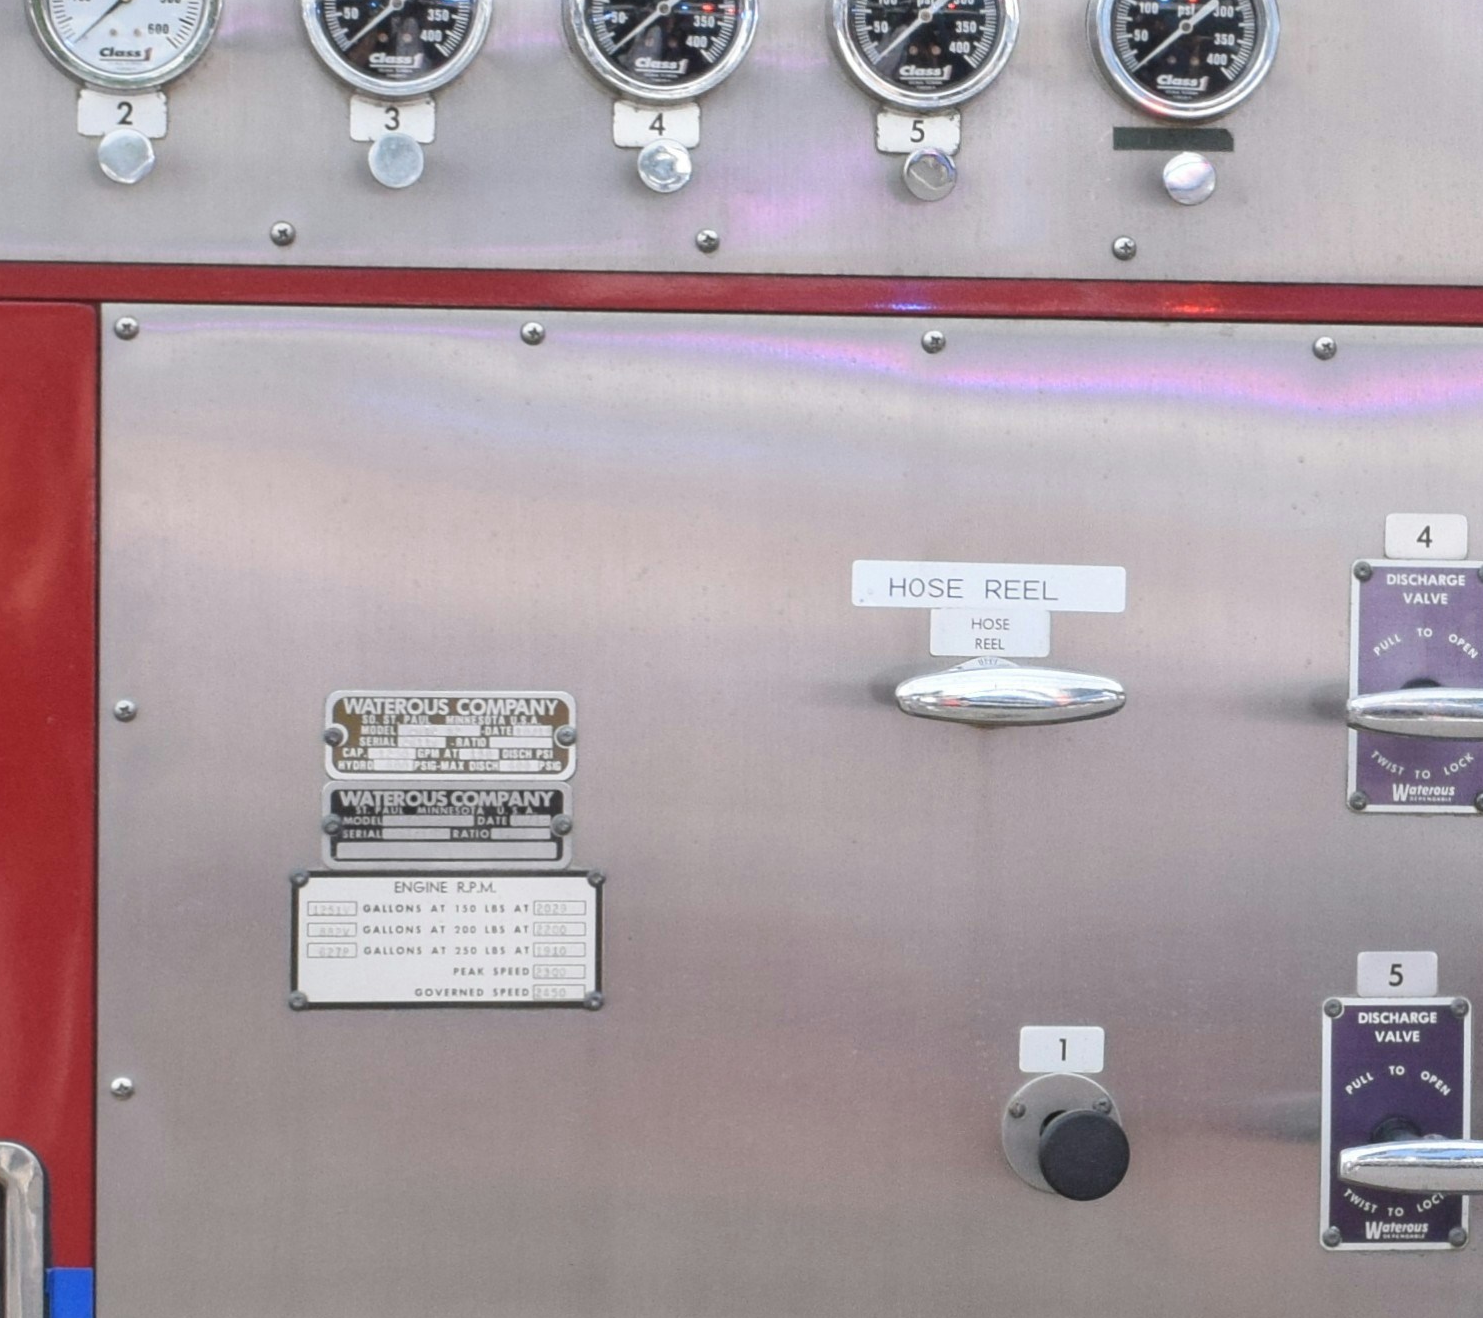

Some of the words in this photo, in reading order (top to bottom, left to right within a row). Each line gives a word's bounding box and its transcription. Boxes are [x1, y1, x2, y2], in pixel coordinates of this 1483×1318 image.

[117, 102, 133, 125] 2
[385, 107, 401, 130] 3
[649, 112, 667, 135] 4
[910, 119, 925, 143] 5
[1417, 526, 1432, 548] 4
[1386, 573, 1466, 586] DISCHARGE
[889, 579, 964, 599] HOSE
[984, 579, 1058, 602] REEL
[1403, 593, 1448, 605] VALVE
[971, 617, 1010, 631] HOSE
[975, 637, 1005, 652] REEL
[1373, 634, 1401, 656] PULL
[1417, 628, 1433, 637] TO
[1448, 634, 1478, 659] OPEN
[343, 698, 449, 715] WATEROUS
[457, 699, 559, 715] COMPANY
[1371, 750, 1404, 775] TWIST
[1415, 770, 1431, 779] TO
[1444, 752, 1474, 775] LOCK
[340, 791, 448, 807] WATEROUS
[451, 791, 554, 807] COMPANY
[1392, 784, 1455, 802] Waterous
[394, 882, 447, 893] ENGINE
[457, 882, 496, 893] R.P.M.
[363, 904, 422, 913] GALLONS
[431, 904, 446, 913] AT
[455, 904, 477, 913] 150
[485, 904, 506, 913] LBS
[514, 904, 529, 913] AT
[453, 967, 485, 976] PEAK
[493, 967, 530, 976] SPEED
[1389, 964, 1404, 986] 5
[415, 988, 484, 997] GOVERNED
[493, 988, 530, 997] SPEED
[1358, 1012, 1437, 1024] DISCHARGE
[1375, 1031, 1420, 1043] VALVE
[1058, 1038, 1068, 1062] 1
